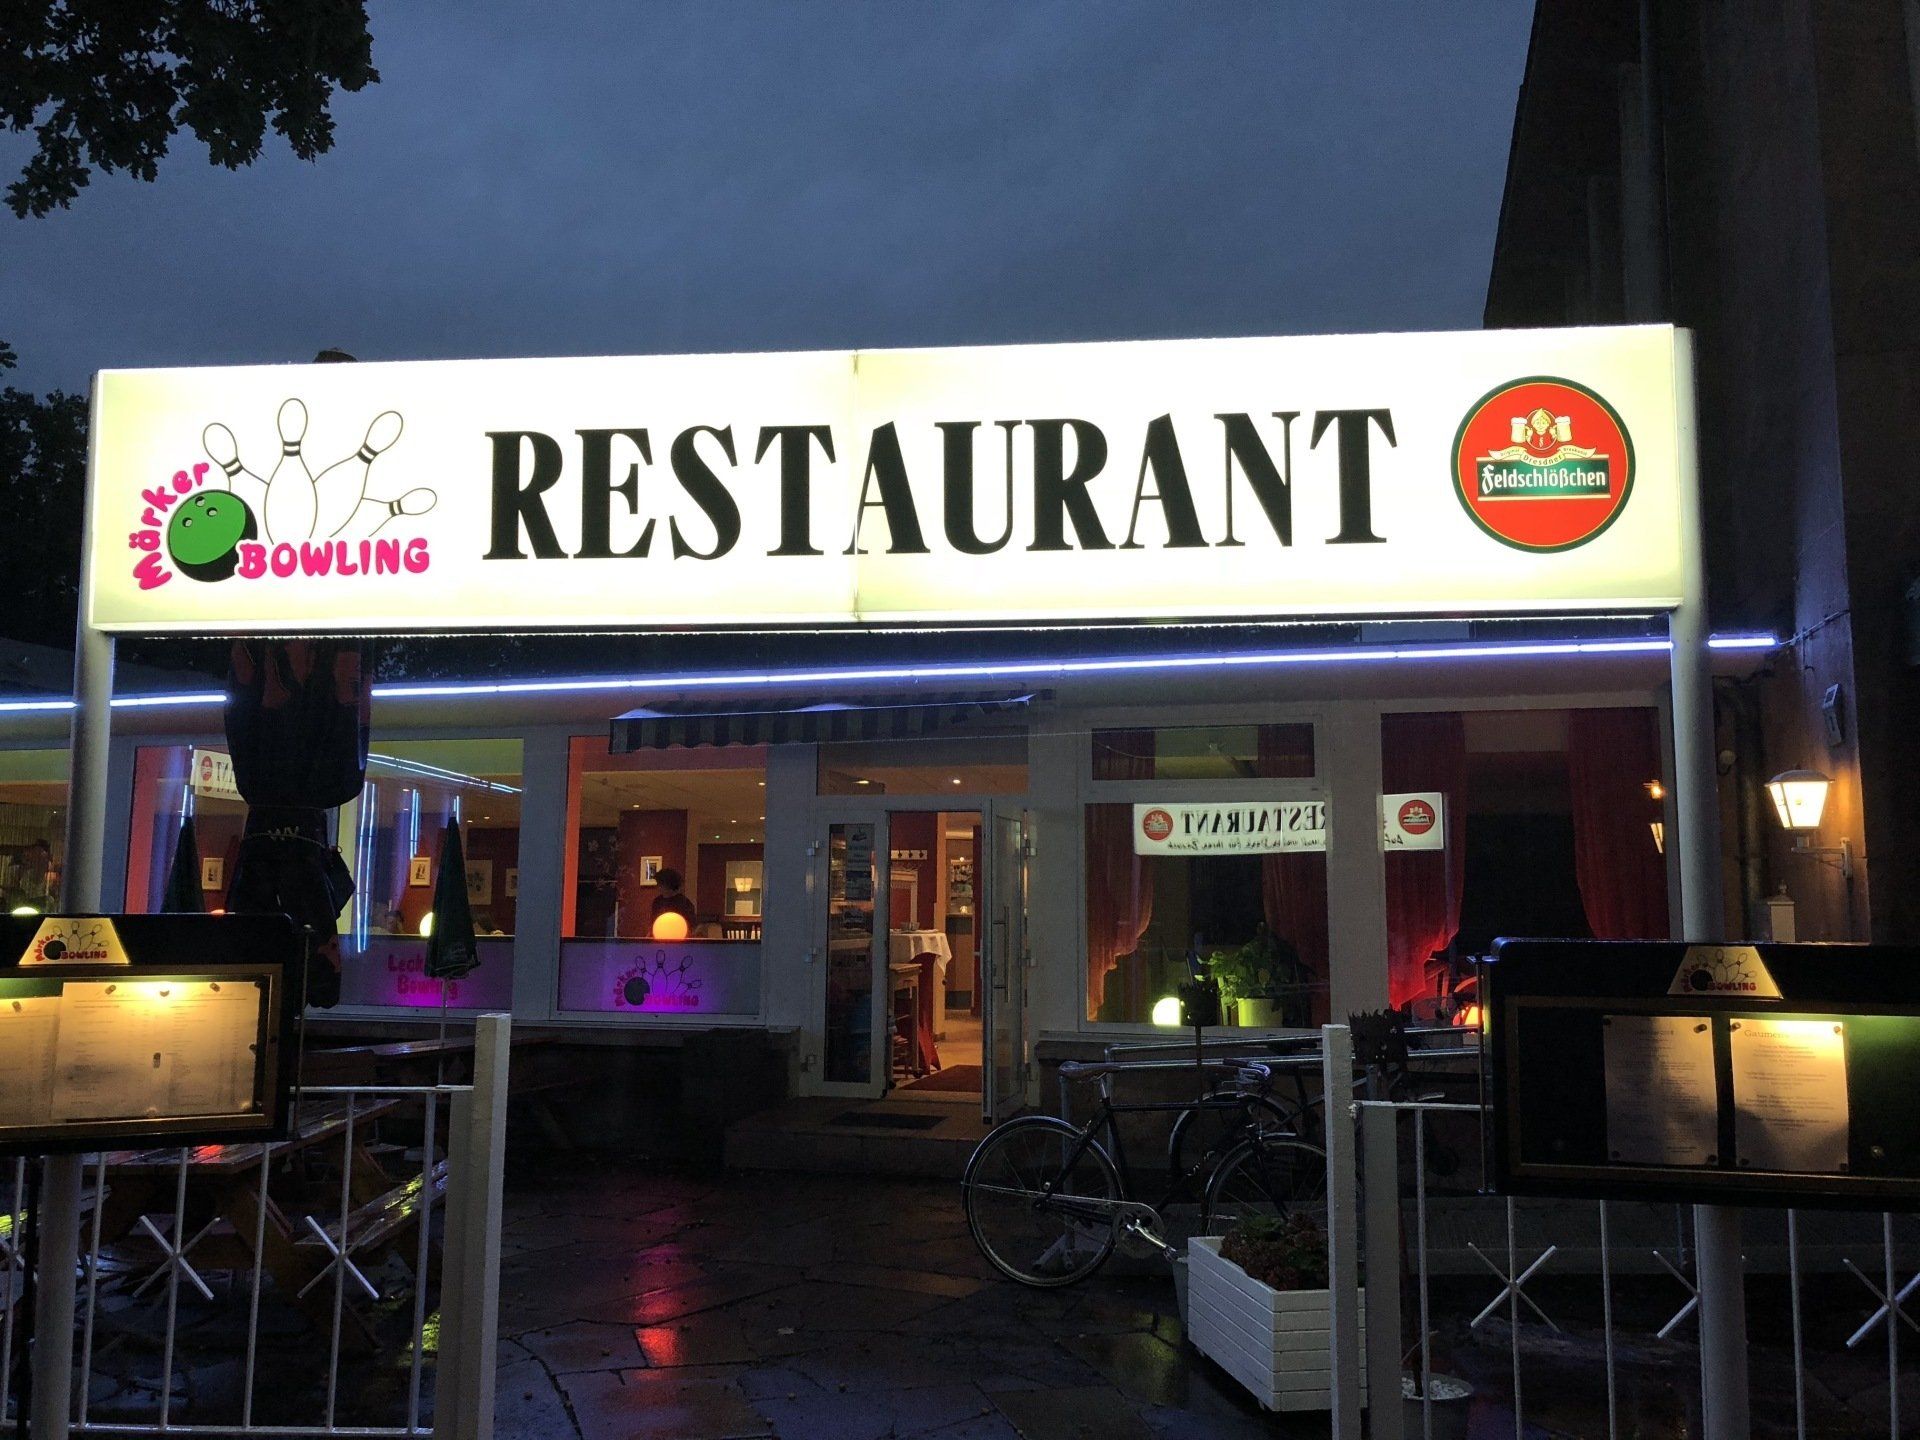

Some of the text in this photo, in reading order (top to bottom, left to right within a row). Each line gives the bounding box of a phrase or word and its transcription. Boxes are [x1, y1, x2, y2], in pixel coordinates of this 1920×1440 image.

[1523, 454, 1563, 466] Dresdner
[482, 407, 1399, 561] RESTAURANT
[1481, 464, 1606, 494] Feldschlößchen
[237, 537, 430, 579] BOWLING
[61, 950, 107, 960] BOWLING
